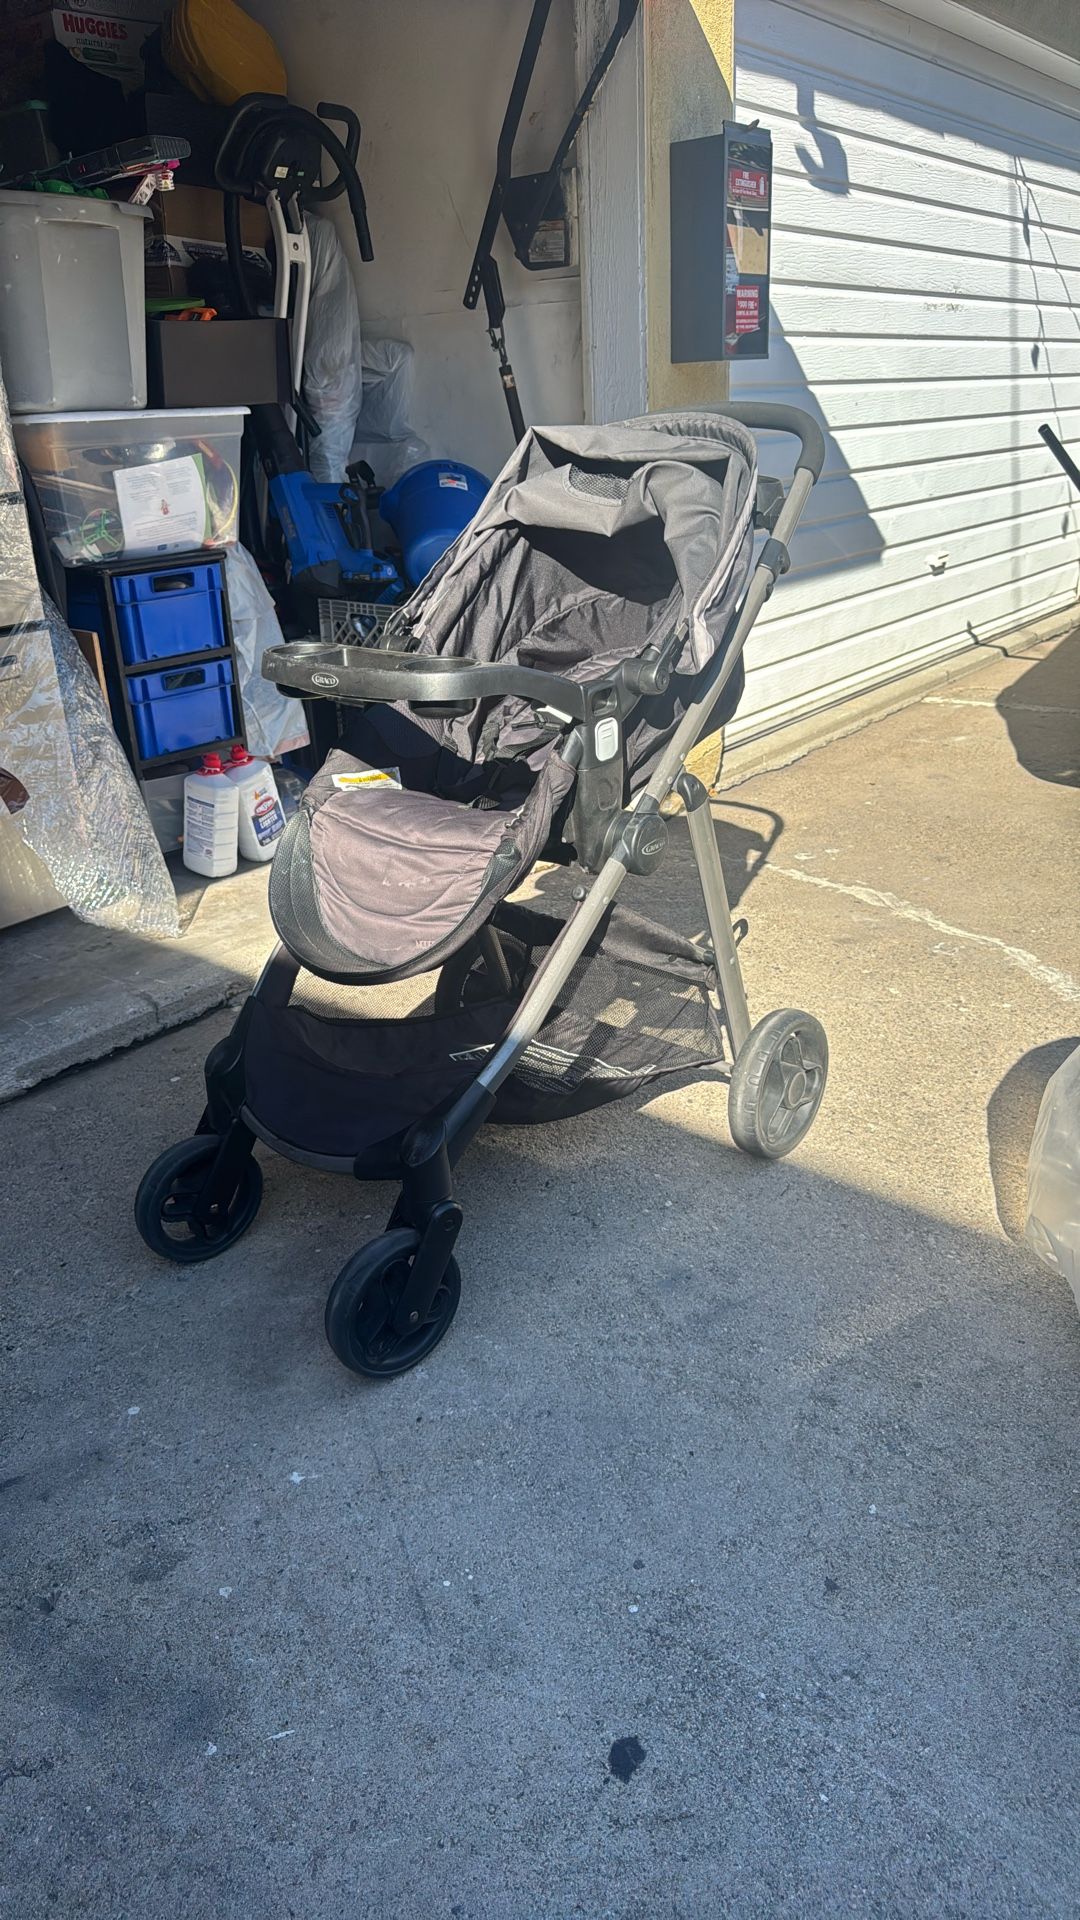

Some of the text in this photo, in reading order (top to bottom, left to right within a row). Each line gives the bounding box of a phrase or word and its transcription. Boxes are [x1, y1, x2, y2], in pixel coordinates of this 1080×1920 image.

[62, 13, 128, 40] HUGGIES
[76, 38, 103, 48] natural
[315, 675, 336, 685] GRACO
[260, 814, 278, 829] LIGHTER
